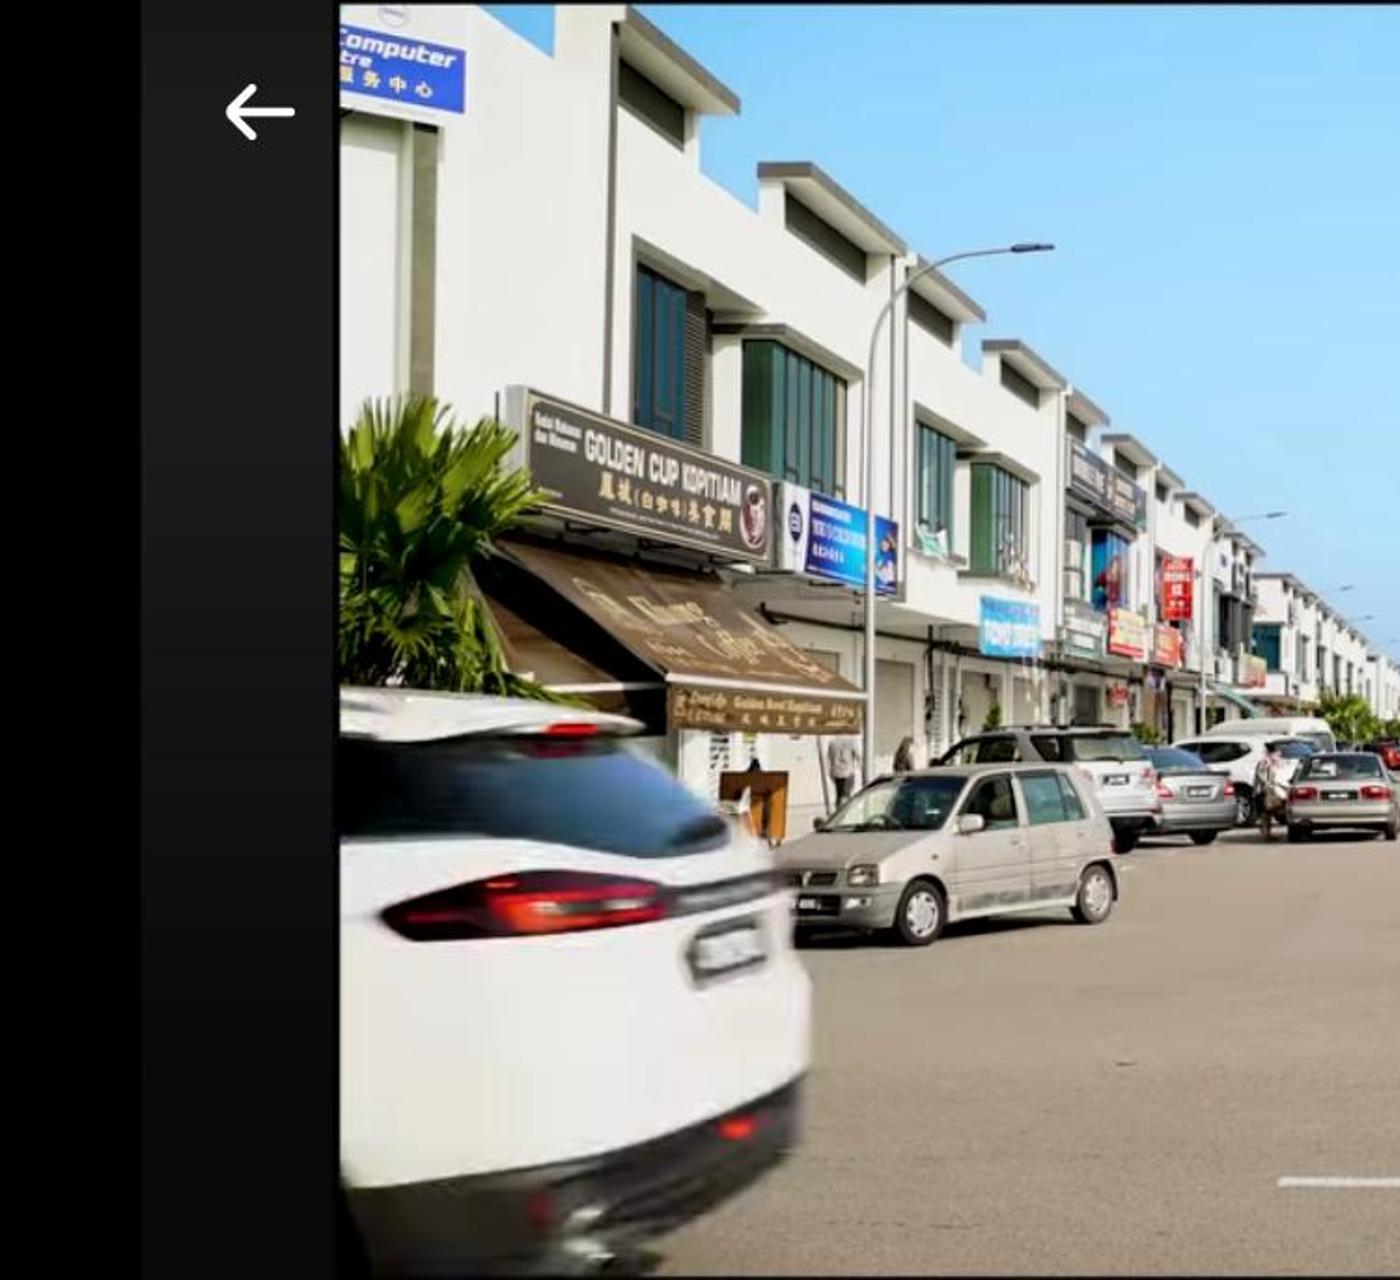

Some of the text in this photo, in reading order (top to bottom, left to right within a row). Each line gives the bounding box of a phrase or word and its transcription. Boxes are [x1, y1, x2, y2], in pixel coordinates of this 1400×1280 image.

[584, 429, 741, 507] GOLDEN CUP KOPITIAM
